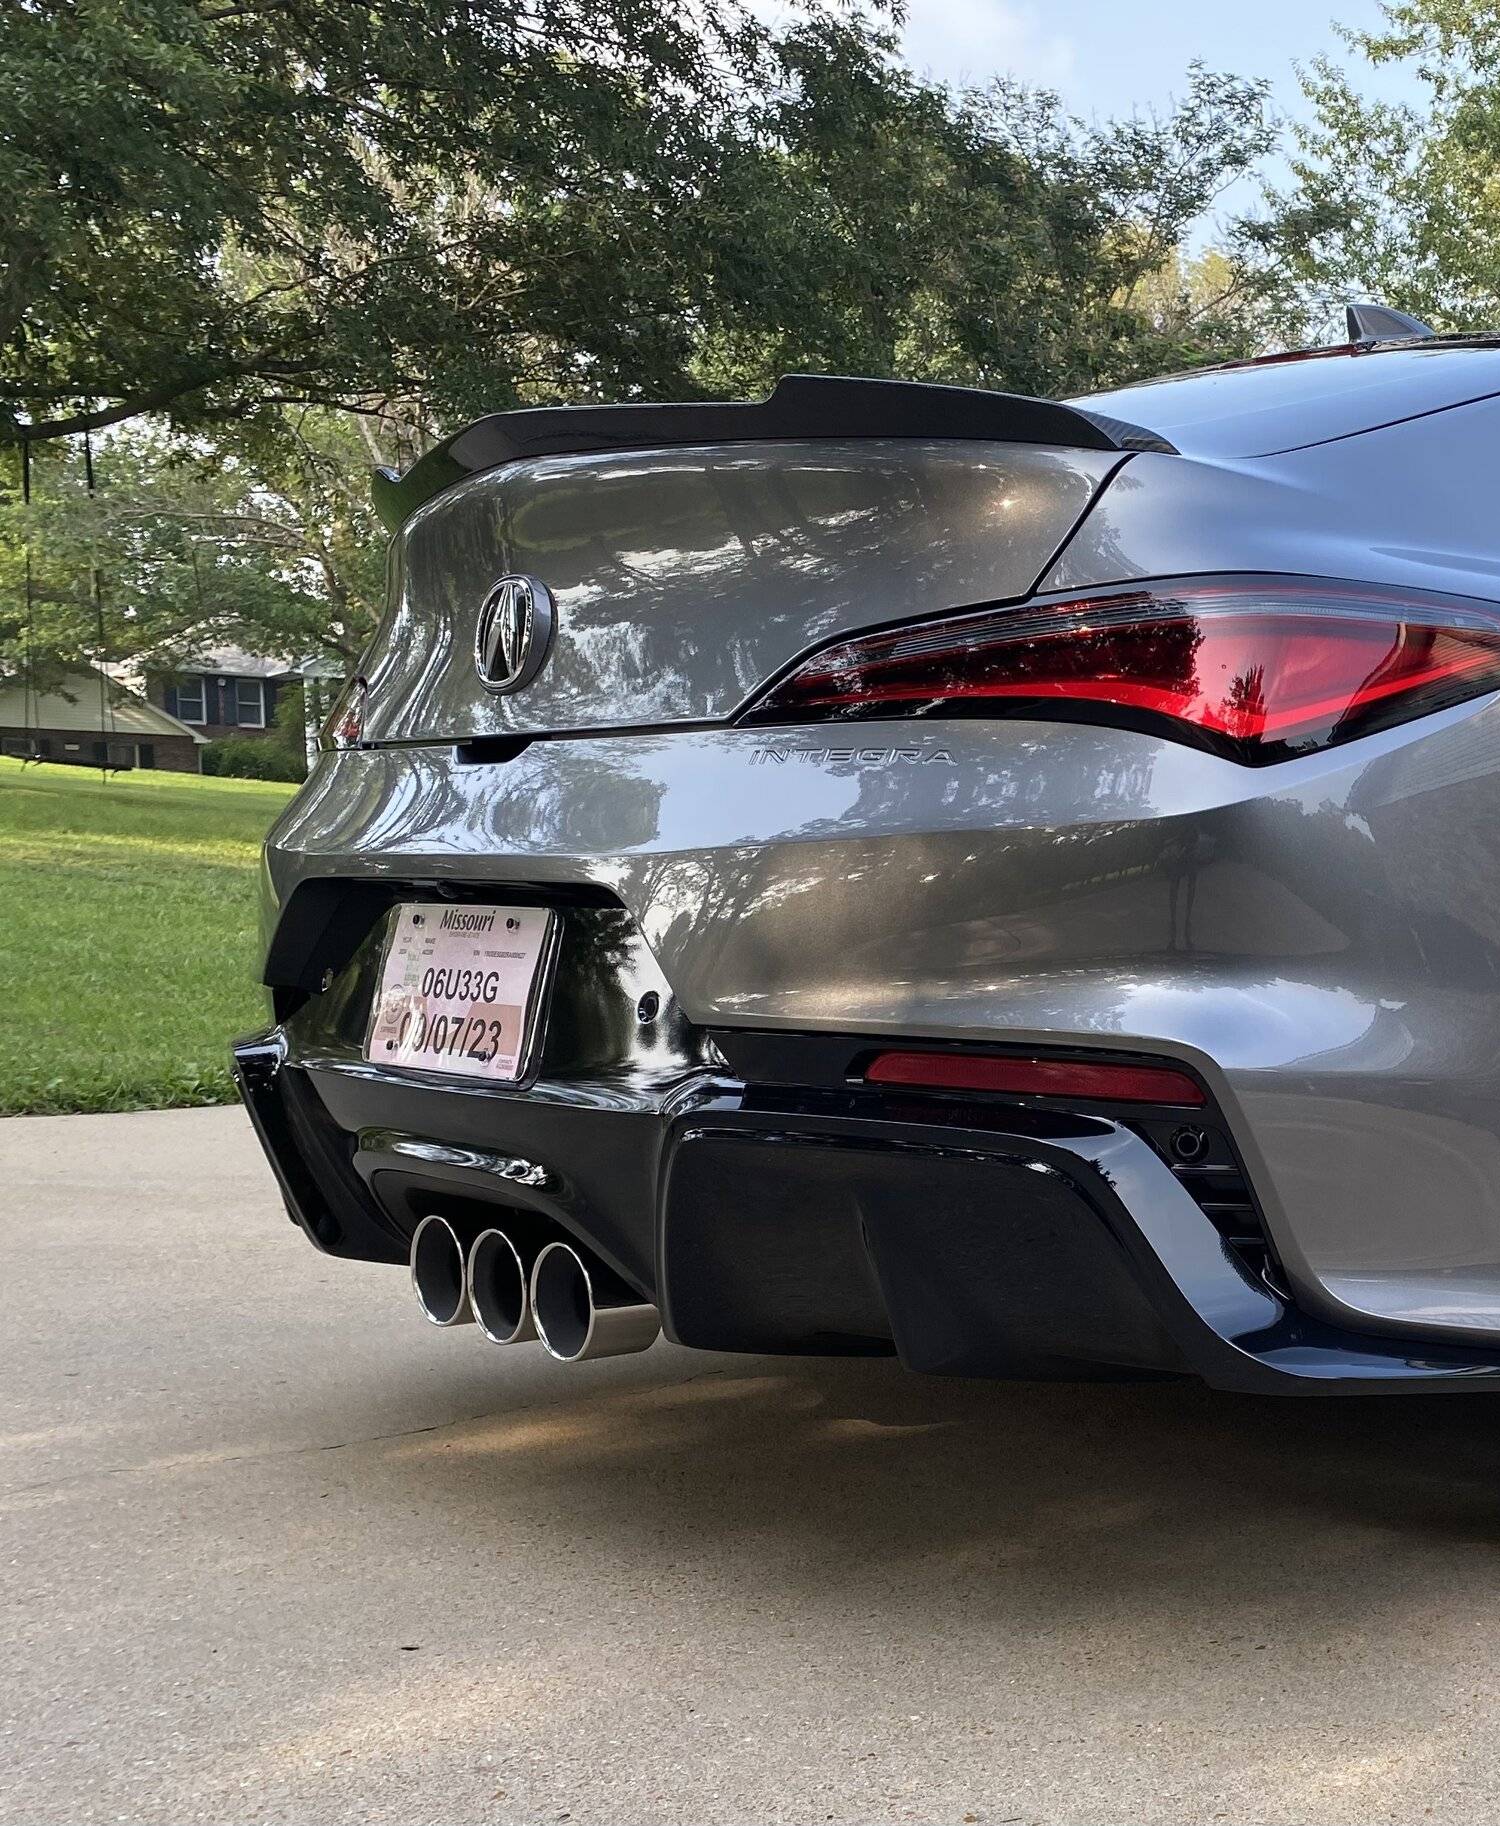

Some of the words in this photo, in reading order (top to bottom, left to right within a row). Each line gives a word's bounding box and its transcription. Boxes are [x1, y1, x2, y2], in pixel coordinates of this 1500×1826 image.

[748, 748, 957, 766] INTEGRA
[440, 909, 496, 931] Missouri
[422, 968, 499, 1003] 06U33G
